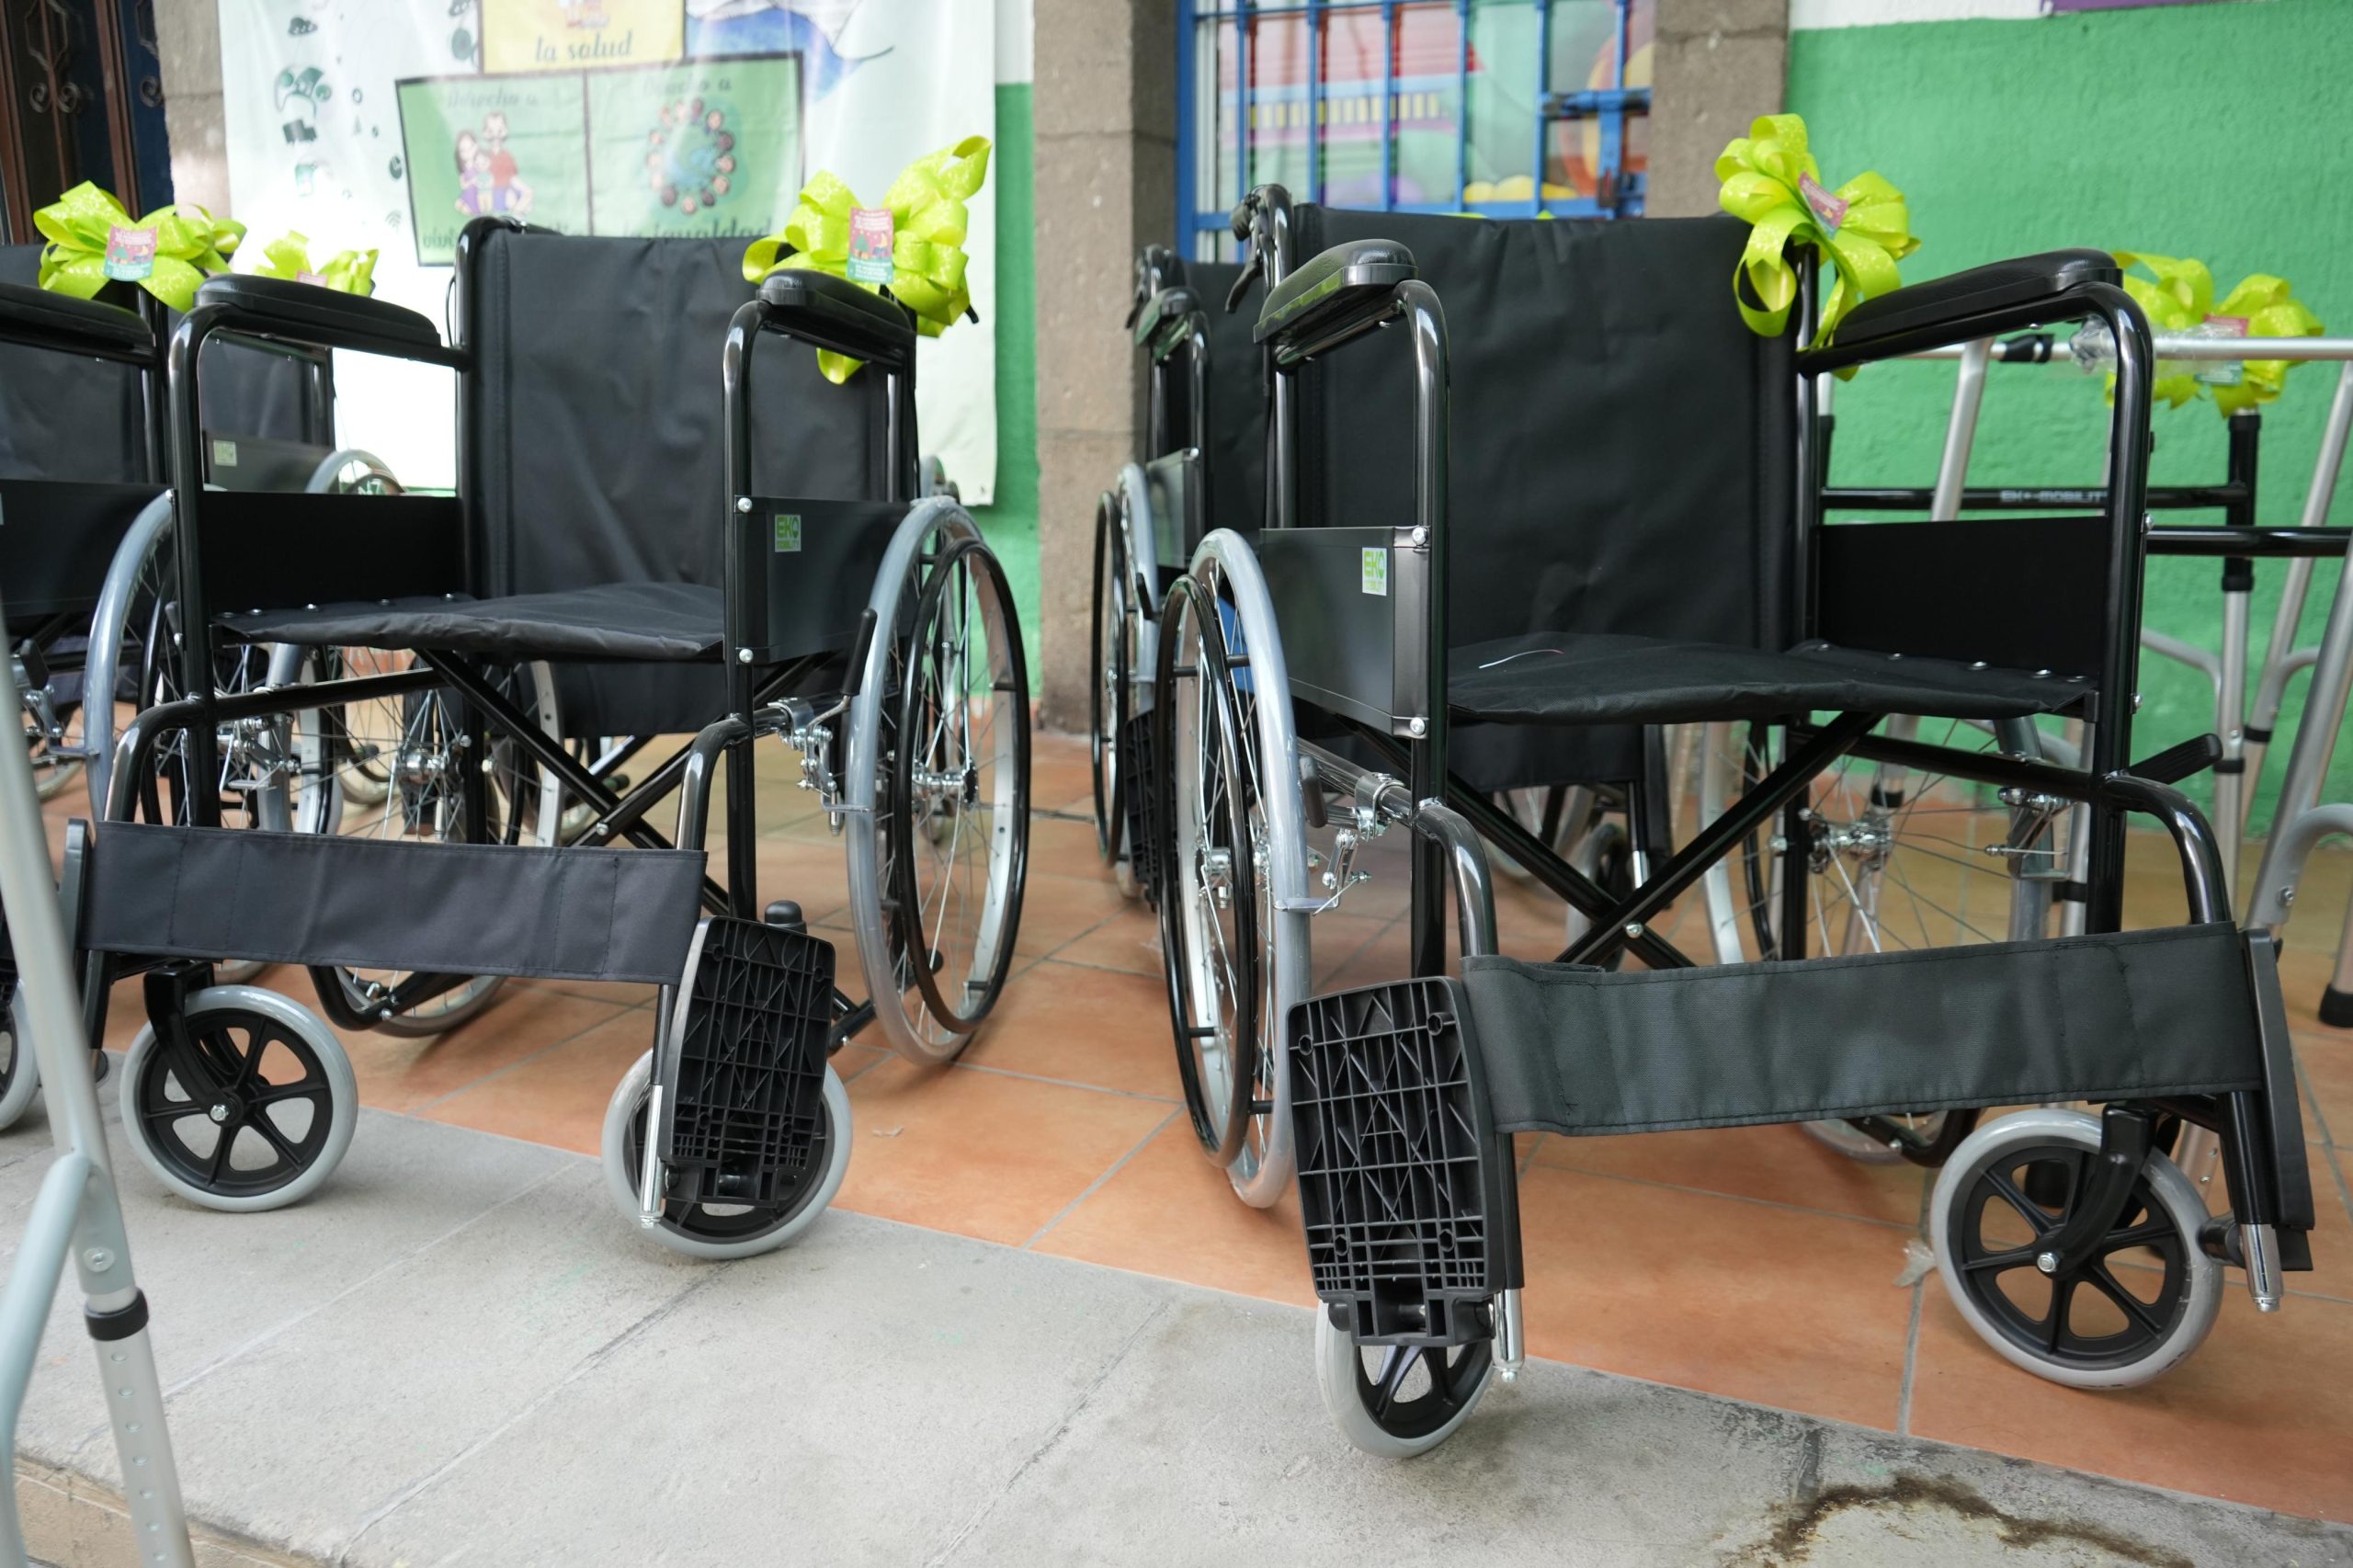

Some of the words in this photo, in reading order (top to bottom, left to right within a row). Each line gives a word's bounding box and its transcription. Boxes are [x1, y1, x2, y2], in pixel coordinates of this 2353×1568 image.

[536, 35, 557, 62] la
[568, 28, 632, 60] salud
[776, 517, 800, 540] EKO
[1364, 551, 1386, 579] EKO
